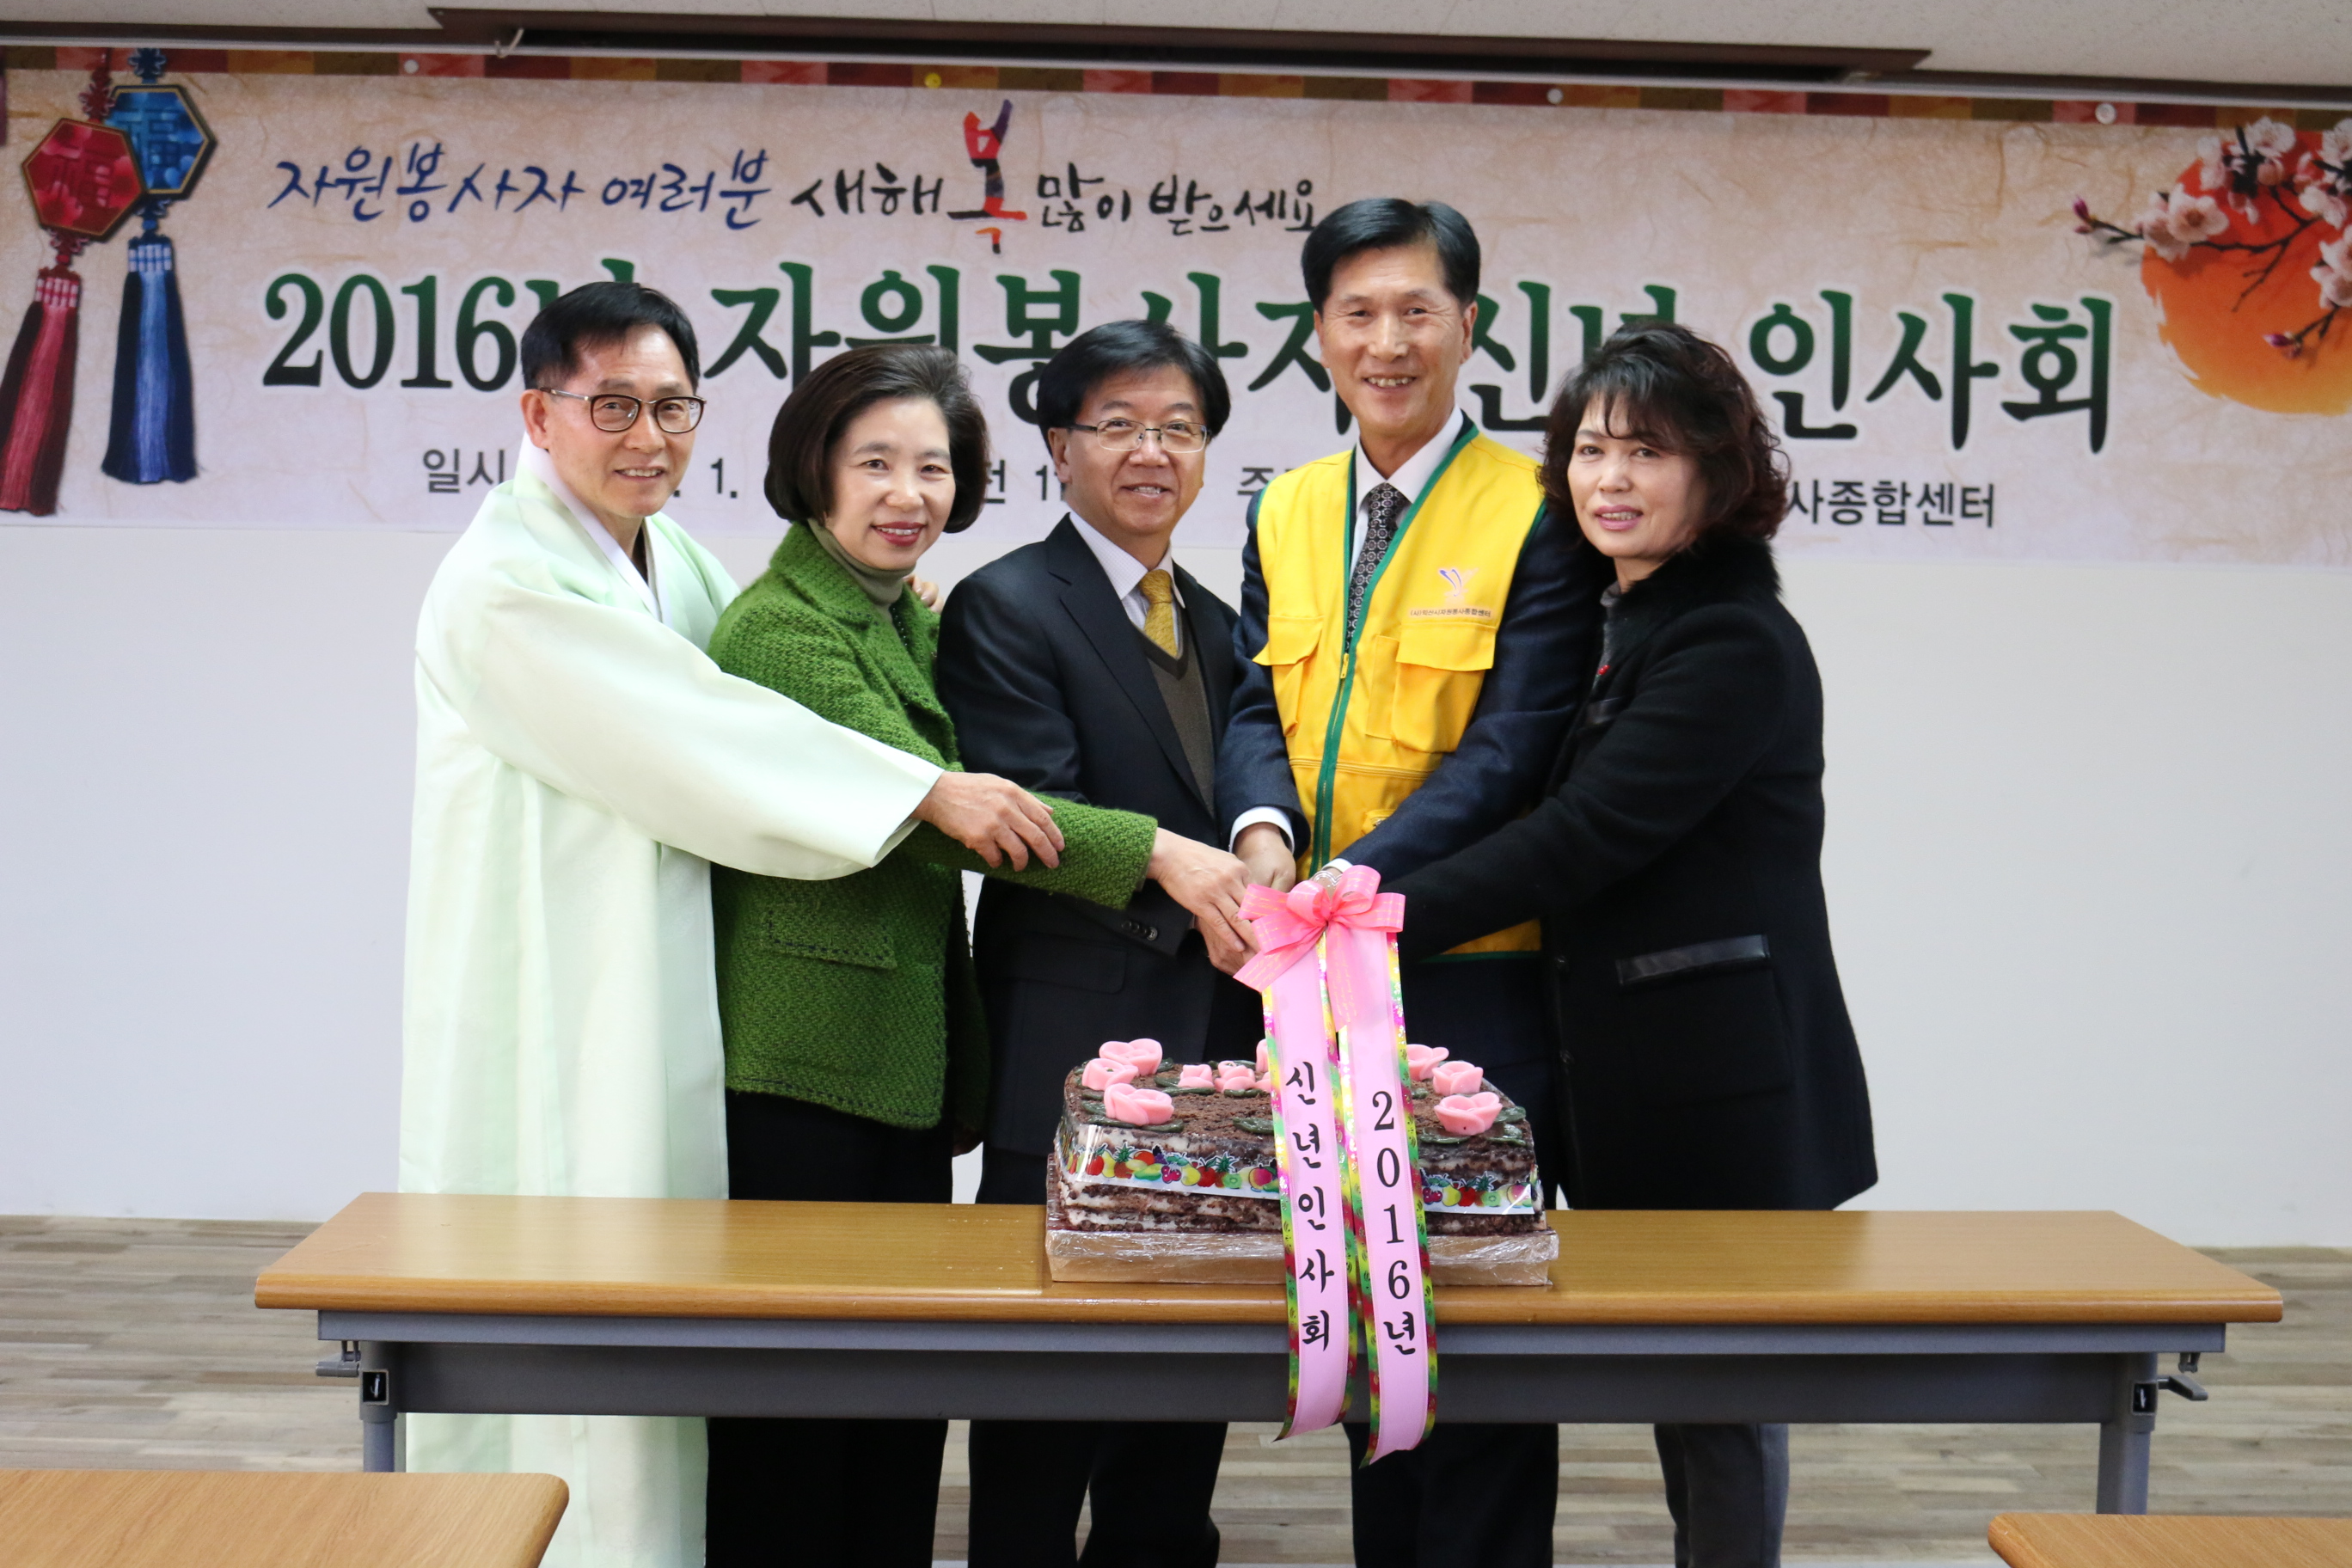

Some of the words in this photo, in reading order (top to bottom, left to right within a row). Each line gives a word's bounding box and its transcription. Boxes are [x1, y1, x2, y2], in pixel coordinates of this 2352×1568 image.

[267, 143, 585, 224] 자원봉사자
[601, 149, 771, 230] 여러분
[791, 162, 944, 217] 새해
[946, 99, 1028, 254] 복
[1037, 162, 1131, 232] 많이
[1148, 175, 1318, 236] 받으세요
[261, 257, 635, 392] 2016
[1748, 290, 2112, 455] 인사회
[422, 448, 505, 494] 일시
[1787, 479, 1994, 528] 사종합센터
[1285, 1061, 1335, 1351] 신년인사회
[1371, 1090, 1418, 1356] 2016년
